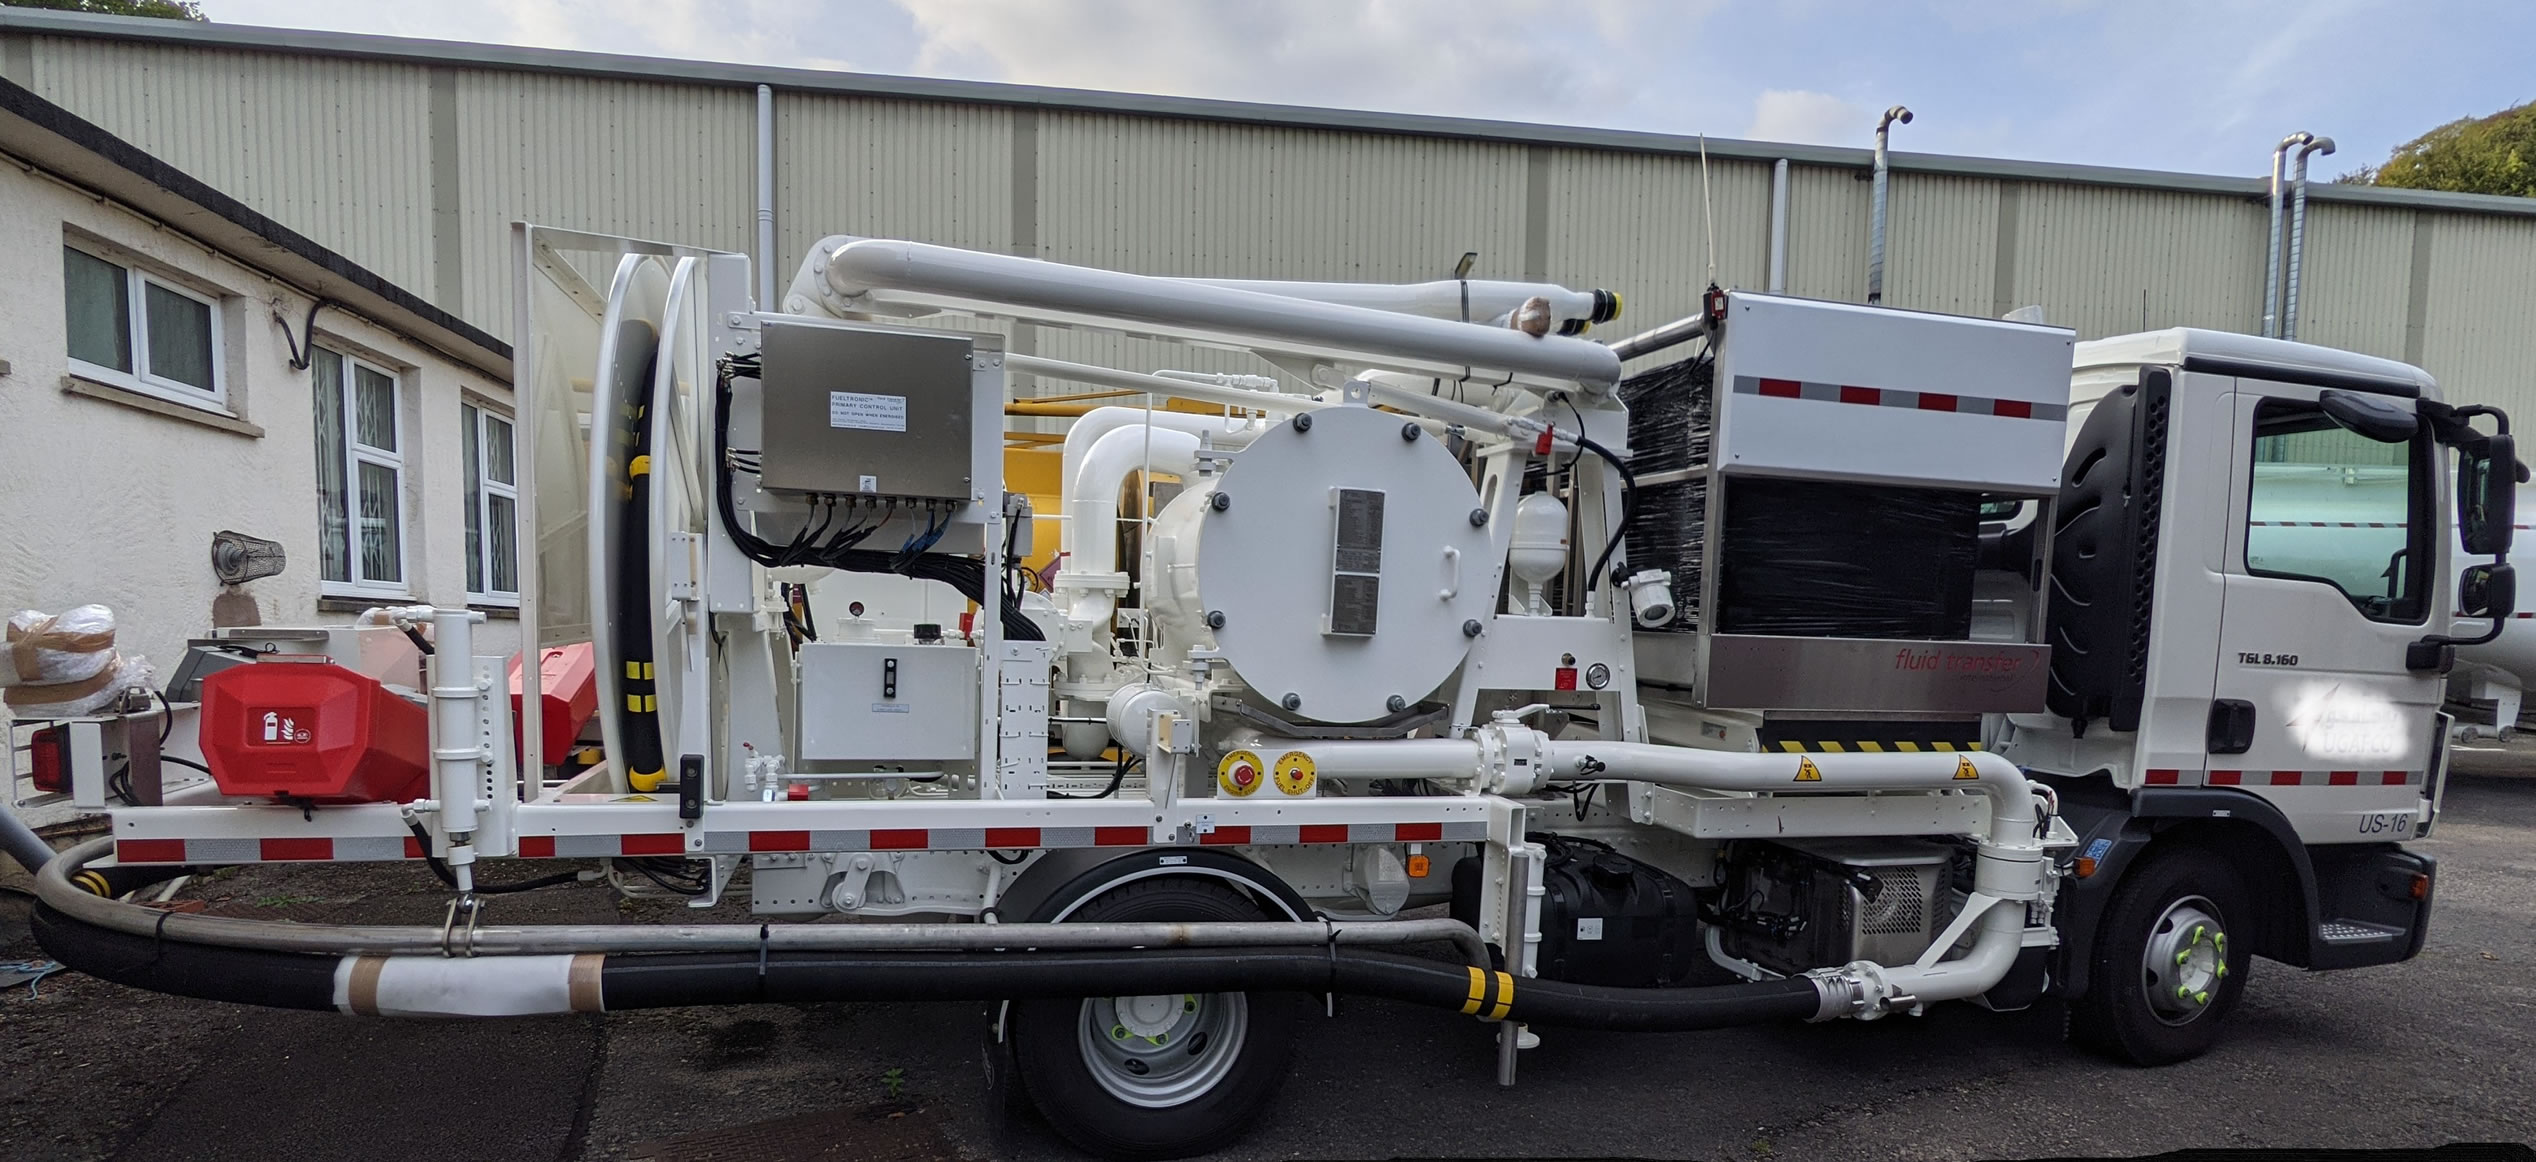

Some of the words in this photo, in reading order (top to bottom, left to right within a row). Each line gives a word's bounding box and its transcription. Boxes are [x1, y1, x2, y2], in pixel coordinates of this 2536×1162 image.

[1895, 648, 1942, 671] fluid
[1946, 651, 2023, 673] transfer
[2262, 653, 2299, 666] 8.160
[1278, 751, 1313, 764] EMERGENCY
[2359, 813, 2408, 834] US-16
